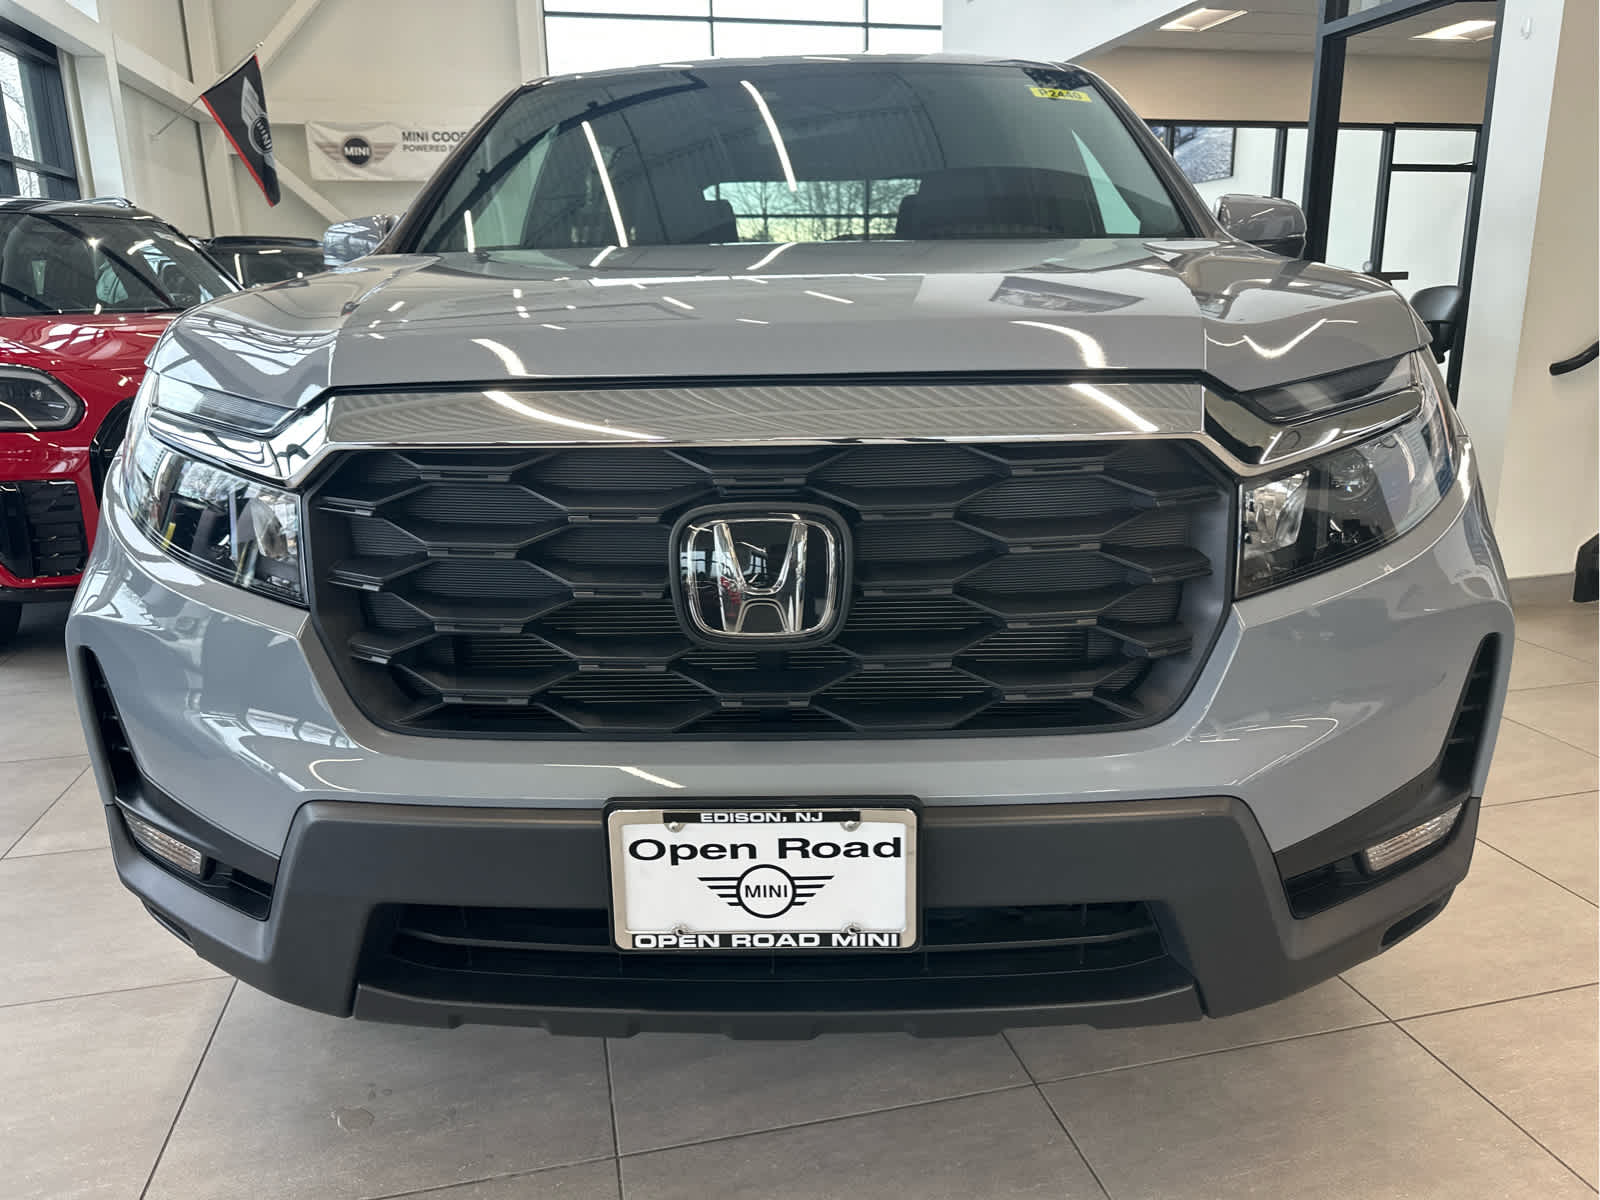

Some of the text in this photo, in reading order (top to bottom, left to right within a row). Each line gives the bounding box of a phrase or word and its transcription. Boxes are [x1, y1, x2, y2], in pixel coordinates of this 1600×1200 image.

[255, 119, 272, 149] MINI
[401, 131, 429, 142] MINI
[344, 146, 370, 156] MINI
[402, 144, 447, 152] POWERED
[700, 812, 823, 823] EDISON, NJ
[628, 837, 902, 866] Open Road
[744, 885, 788, 898] MINI
[634, 934, 898, 948] OPEN ROAD MINI
